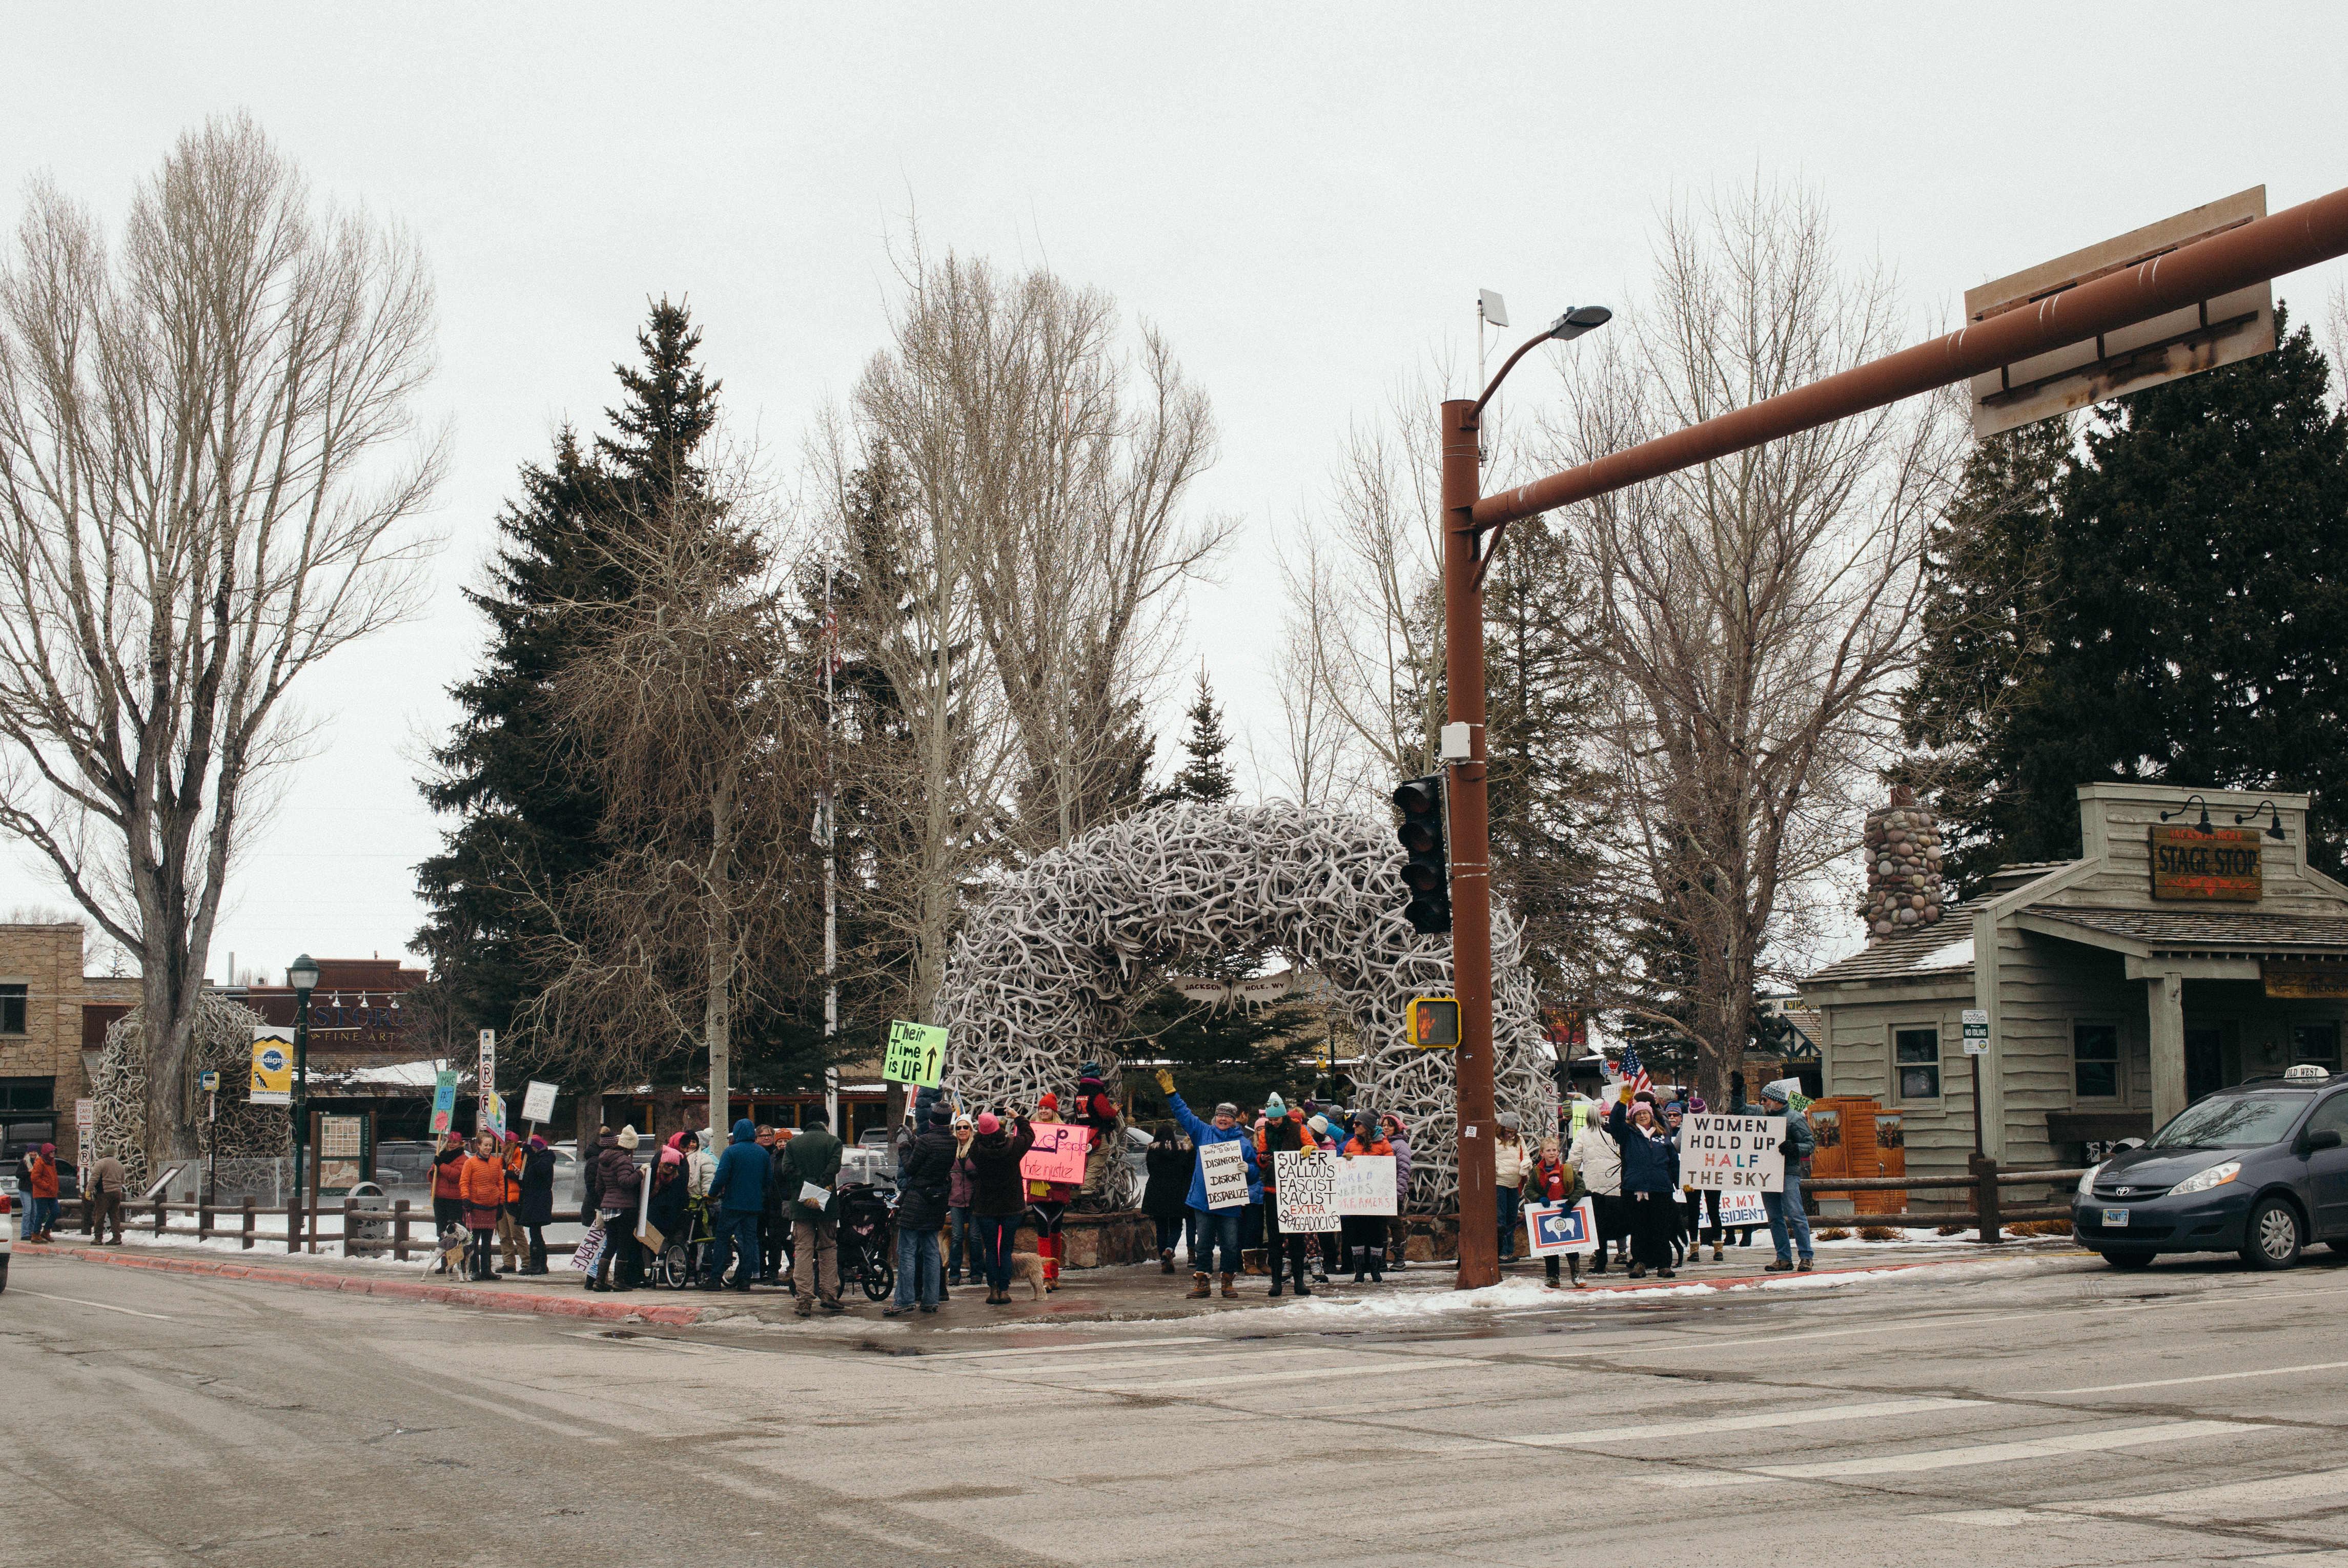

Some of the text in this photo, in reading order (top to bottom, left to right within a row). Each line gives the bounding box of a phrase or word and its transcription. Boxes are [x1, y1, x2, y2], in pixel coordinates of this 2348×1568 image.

[2217, 830, 2242, 841] HOLE
[2159, 845, 2257, 876] STAGE STOP
[325, 1033, 359, 1041] FINE
[368, 1033, 395, 1041] ART
[894, 1022, 926, 1042] Their
[891, 1039, 921, 1058] Time
[254, 1055, 291, 1064] Pedigree
[888, 1057, 922, 1081] is UP
[2286, 1067, 2318, 1077] OLD WEST
[1792, 1094, 1809, 1105] BLACK
[1793, 1100, 1807, 1109] LIVE
[1694, 1118, 1767, 1132] WOMEN
[1690, 1135, 1775, 1150] HOLD UP
[1204, 1155, 1241, 1169] DISINFORM
[1278, 1152, 1327, 1166] SUPER
[1705, 1153, 1758, 1168] HALF
[1024, 1157, 1073, 1181] hate injustice
[1278, 1165, 1335, 1179] CALLOUS
[1210, 1172, 1241, 1186] DISTORT
[1280, 1179, 1335, 1192] FASCIST
[1688, 1171, 1771, 1187] THE SKY
[1208, 1188, 1248, 1204] DESTABLIZE
[1280, 1191, 1336, 1205] RACIST
[1736, 1194, 1755, 1207] MY
[1291, 1205, 1325, 1214] EXTRA
[1699, 1208, 1765, 1224] PSIDENT
[1278, 1209, 1340, 1231] BRAGGADOCIOS
